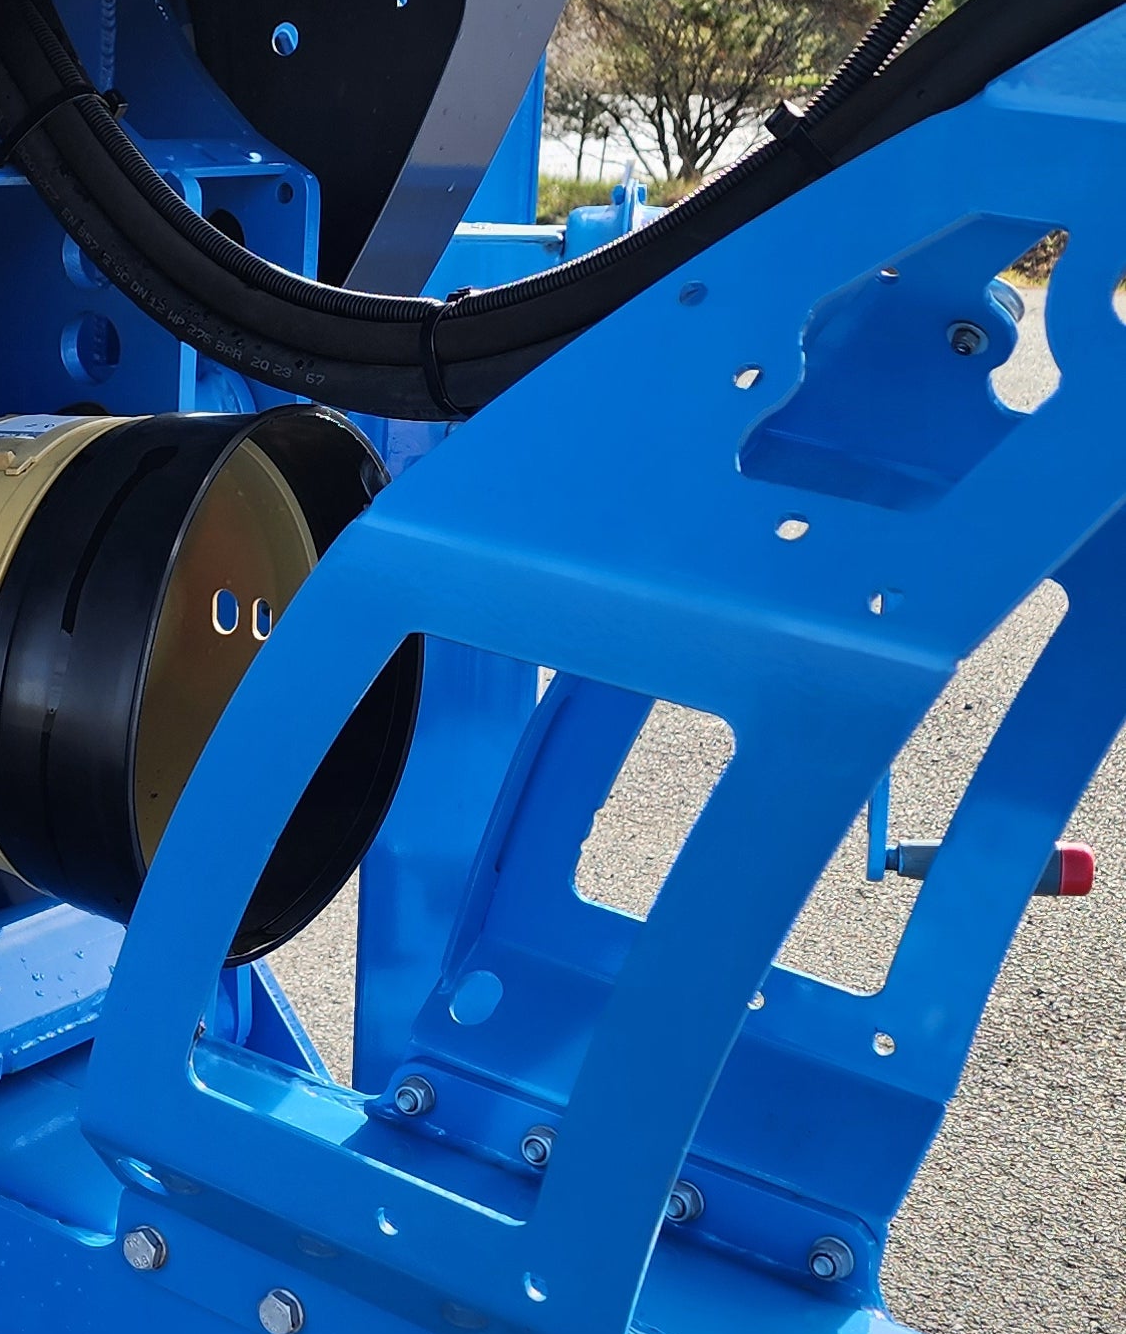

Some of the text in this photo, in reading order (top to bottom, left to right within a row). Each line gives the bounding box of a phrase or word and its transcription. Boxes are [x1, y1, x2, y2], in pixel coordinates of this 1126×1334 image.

[130, 280, 148, 299] DN
[167, 310, 186, 325] WP
[187, 323, 212, 344] 275
[215, 340, 242, 360] BAR
[272, 363, 292, 379] 23
[305, 372, 326, 386] 67
